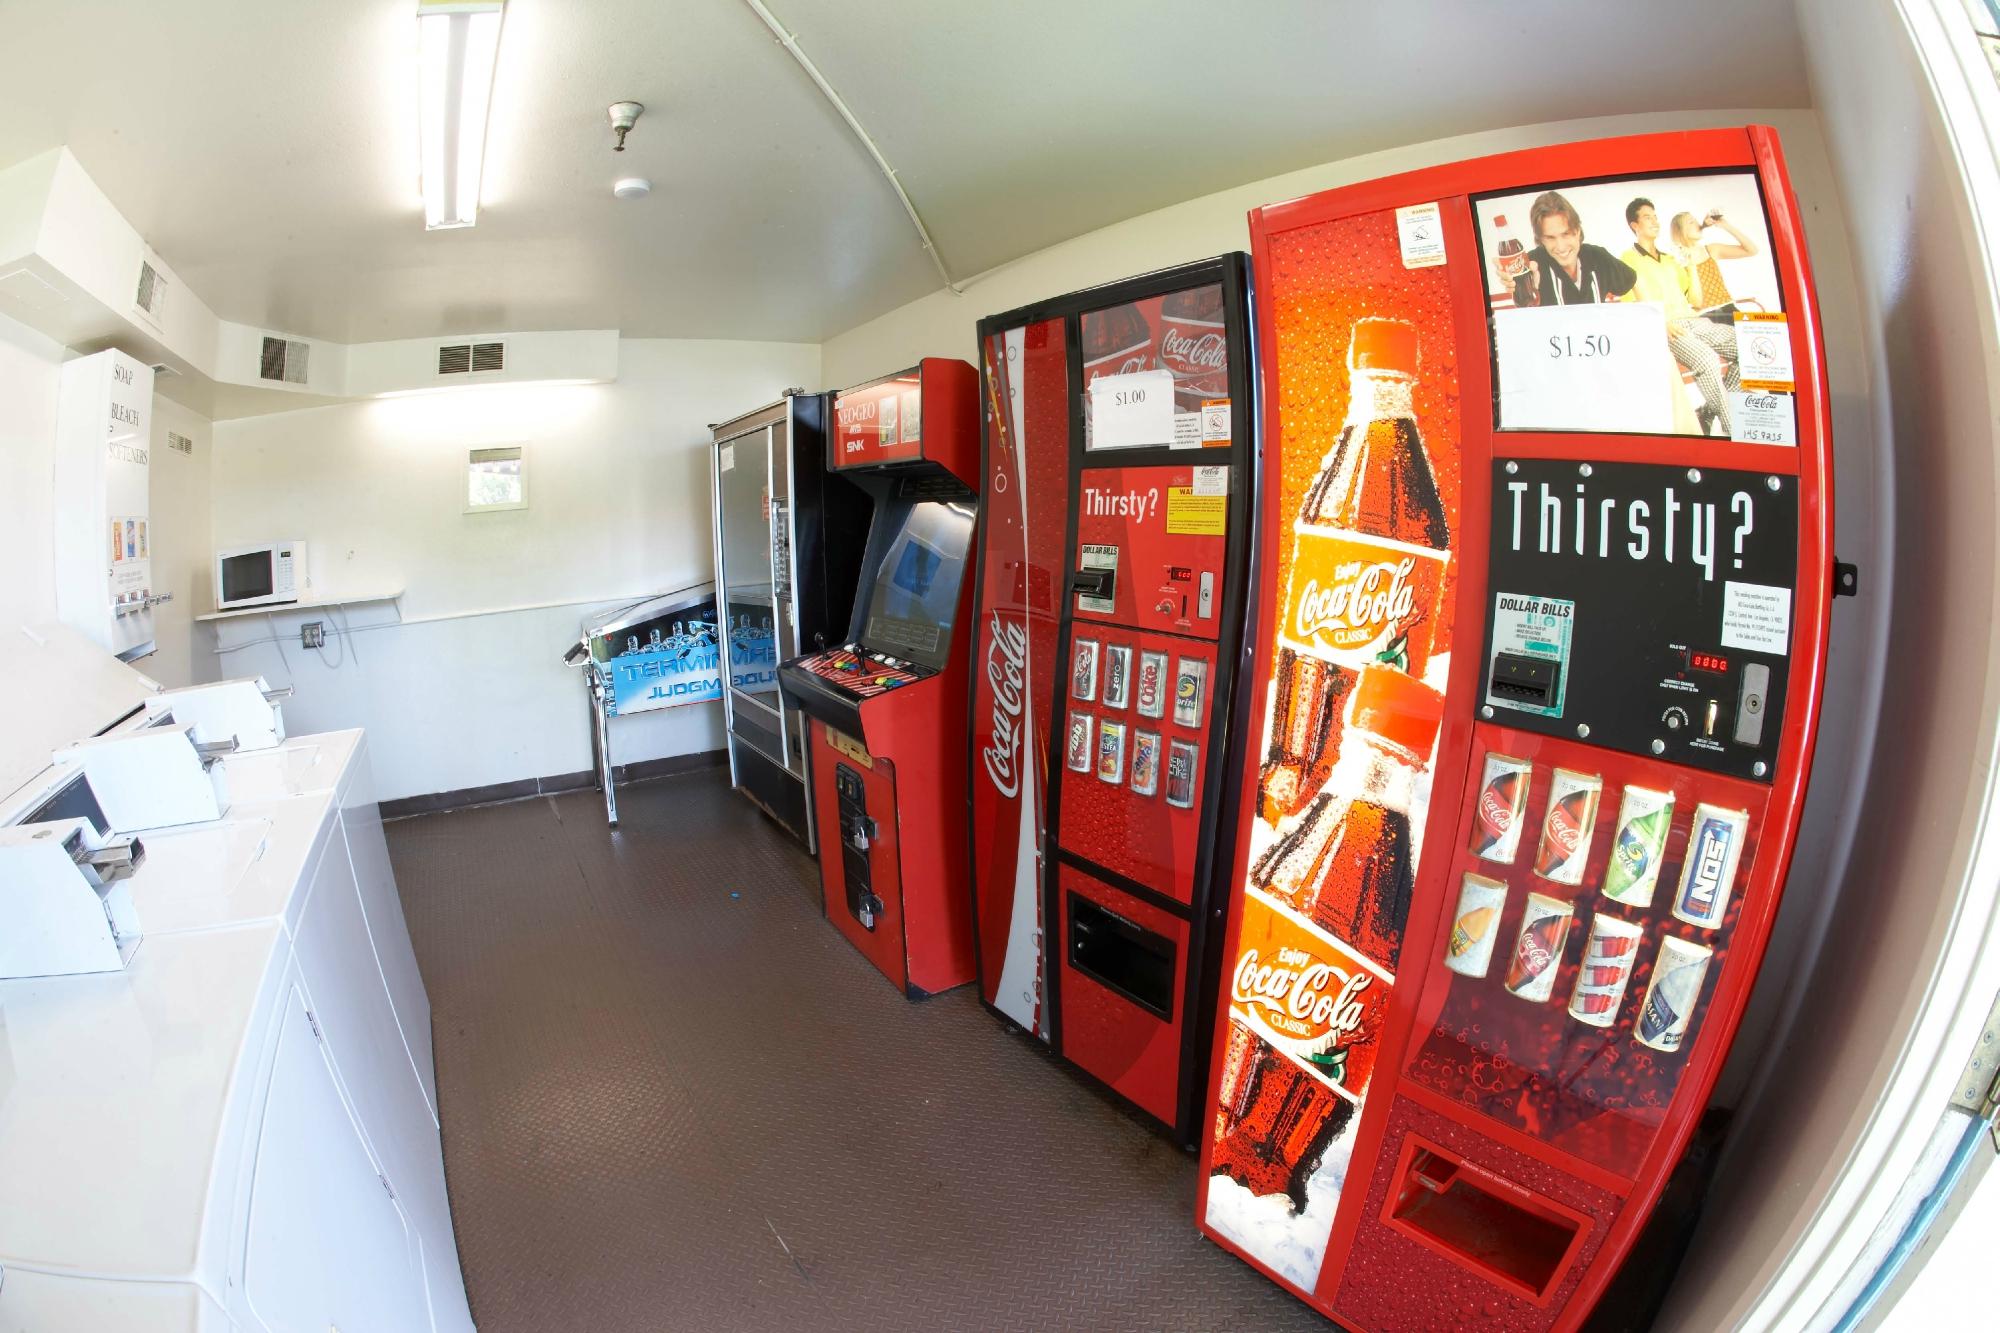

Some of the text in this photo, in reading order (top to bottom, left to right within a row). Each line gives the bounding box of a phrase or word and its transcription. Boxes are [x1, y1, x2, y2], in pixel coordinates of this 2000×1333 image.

[1162, 328, 1227, 371] Coca-Cola
[1549, 334, 1611, 359] $1.50
[113, 363, 134, 386] SOAP
[1115, 389, 1146, 406] $1.00
[111, 402, 139, 427] BLEACH
[846, 439, 865, 453] SNK
[1085, 488, 1159, 524] Thirsty?
[1508, 481, 1754, 582] Thirsty?
[1296, 556, 1417, 637] Coca-Cola
[1500, 597, 1571, 618] DOLLAR BILLS
[1334, 628, 1373, 644] CLASSIC
[1113, 664, 1121, 689] zero
[983, 607, 1027, 799] Coca-Cola
[1690, 829, 1727, 903] NOS
[1278, 946, 1311, 968] Enjoy
[1231, 949, 1374, 1031] Coca-Cola
[1270, 1013, 1311, 1037] CLASSIC
[1479, 1169, 1493, 1179] open
